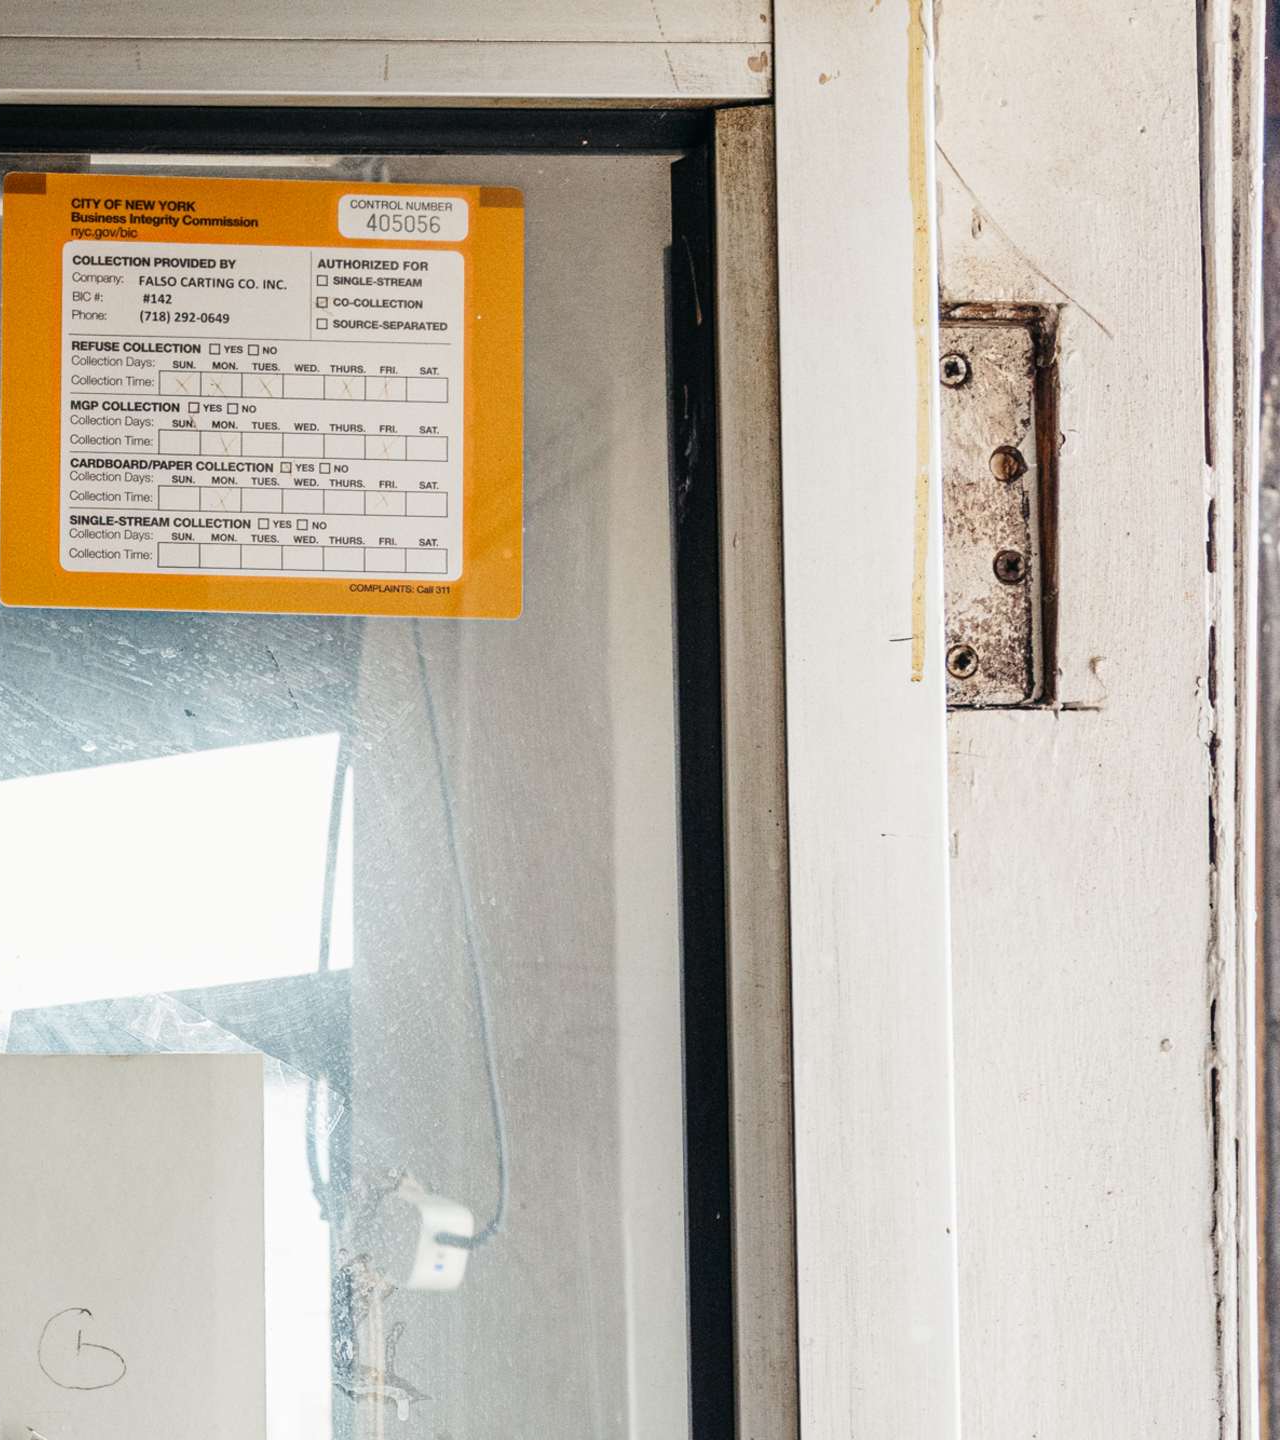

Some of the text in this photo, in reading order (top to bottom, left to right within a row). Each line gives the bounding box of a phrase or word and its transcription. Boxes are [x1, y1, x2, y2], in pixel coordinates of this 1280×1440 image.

[71, 199, 196, 212] CITY OF NEW YORK
[350, 200, 453, 212] CONTROL NUMBER
[71, 212, 258, 228] Business Integrity Commission
[366, 213, 441, 233] 405056
[71, 227, 138, 239] nyc.gov/bic
[72, 256, 236, 269] COLLECTION PROVIDED BY
[317, 259, 429, 271] AUTHORIZED FOR
[72, 272, 287, 290] Company: FALSO CARTING CO. INC.
[332, 276, 422, 287] SINGLE-STREAM
[73, 291, 173, 304] BIC #: #142
[333, 298, 423, 309] CO-COLLECTION
[72, 309, 230, 324] Phone: (718) 292-0649
[332, 320, 448, 331] SOURCE-SEPARATED
[71, 341, 278, 355] REFUSE COLLECTION YES NO
[71, 355, 440, 376] Collection Days: SUN. MON. TUES. WED. THURS. FRI. SAT.
[71, 375, 155, 387] Collection Time:
[70, 401, 256, 413] MGP COLLECTION YES NO
[70, 415, 440, 434] Collection Days: SUN. MON. TUES. WED. THURS. FRI. SAT.
[70, 435, 153, 446] Collection Time:
[70, 458, 349, 473] CARDBOARD/PAPER COLLECTION YES NO
[70, 471, 439, 490] Collection Days: SUN. MON. TUES. WED. THURS. FRI. SAT.
[69, 490, 153, 502] Collection Time:
[70, 515, 327, 530] SINGLE-STREAM COLLECTION YES NO
[69, 528, 439, 547] Collection Days: SUN. MON. TUES. WED. THURS. FRI. SAT.
[69, 548, 153, 560] Collection Time:
[349, 584, 450, 594] COMPLAINTS: Call 311
